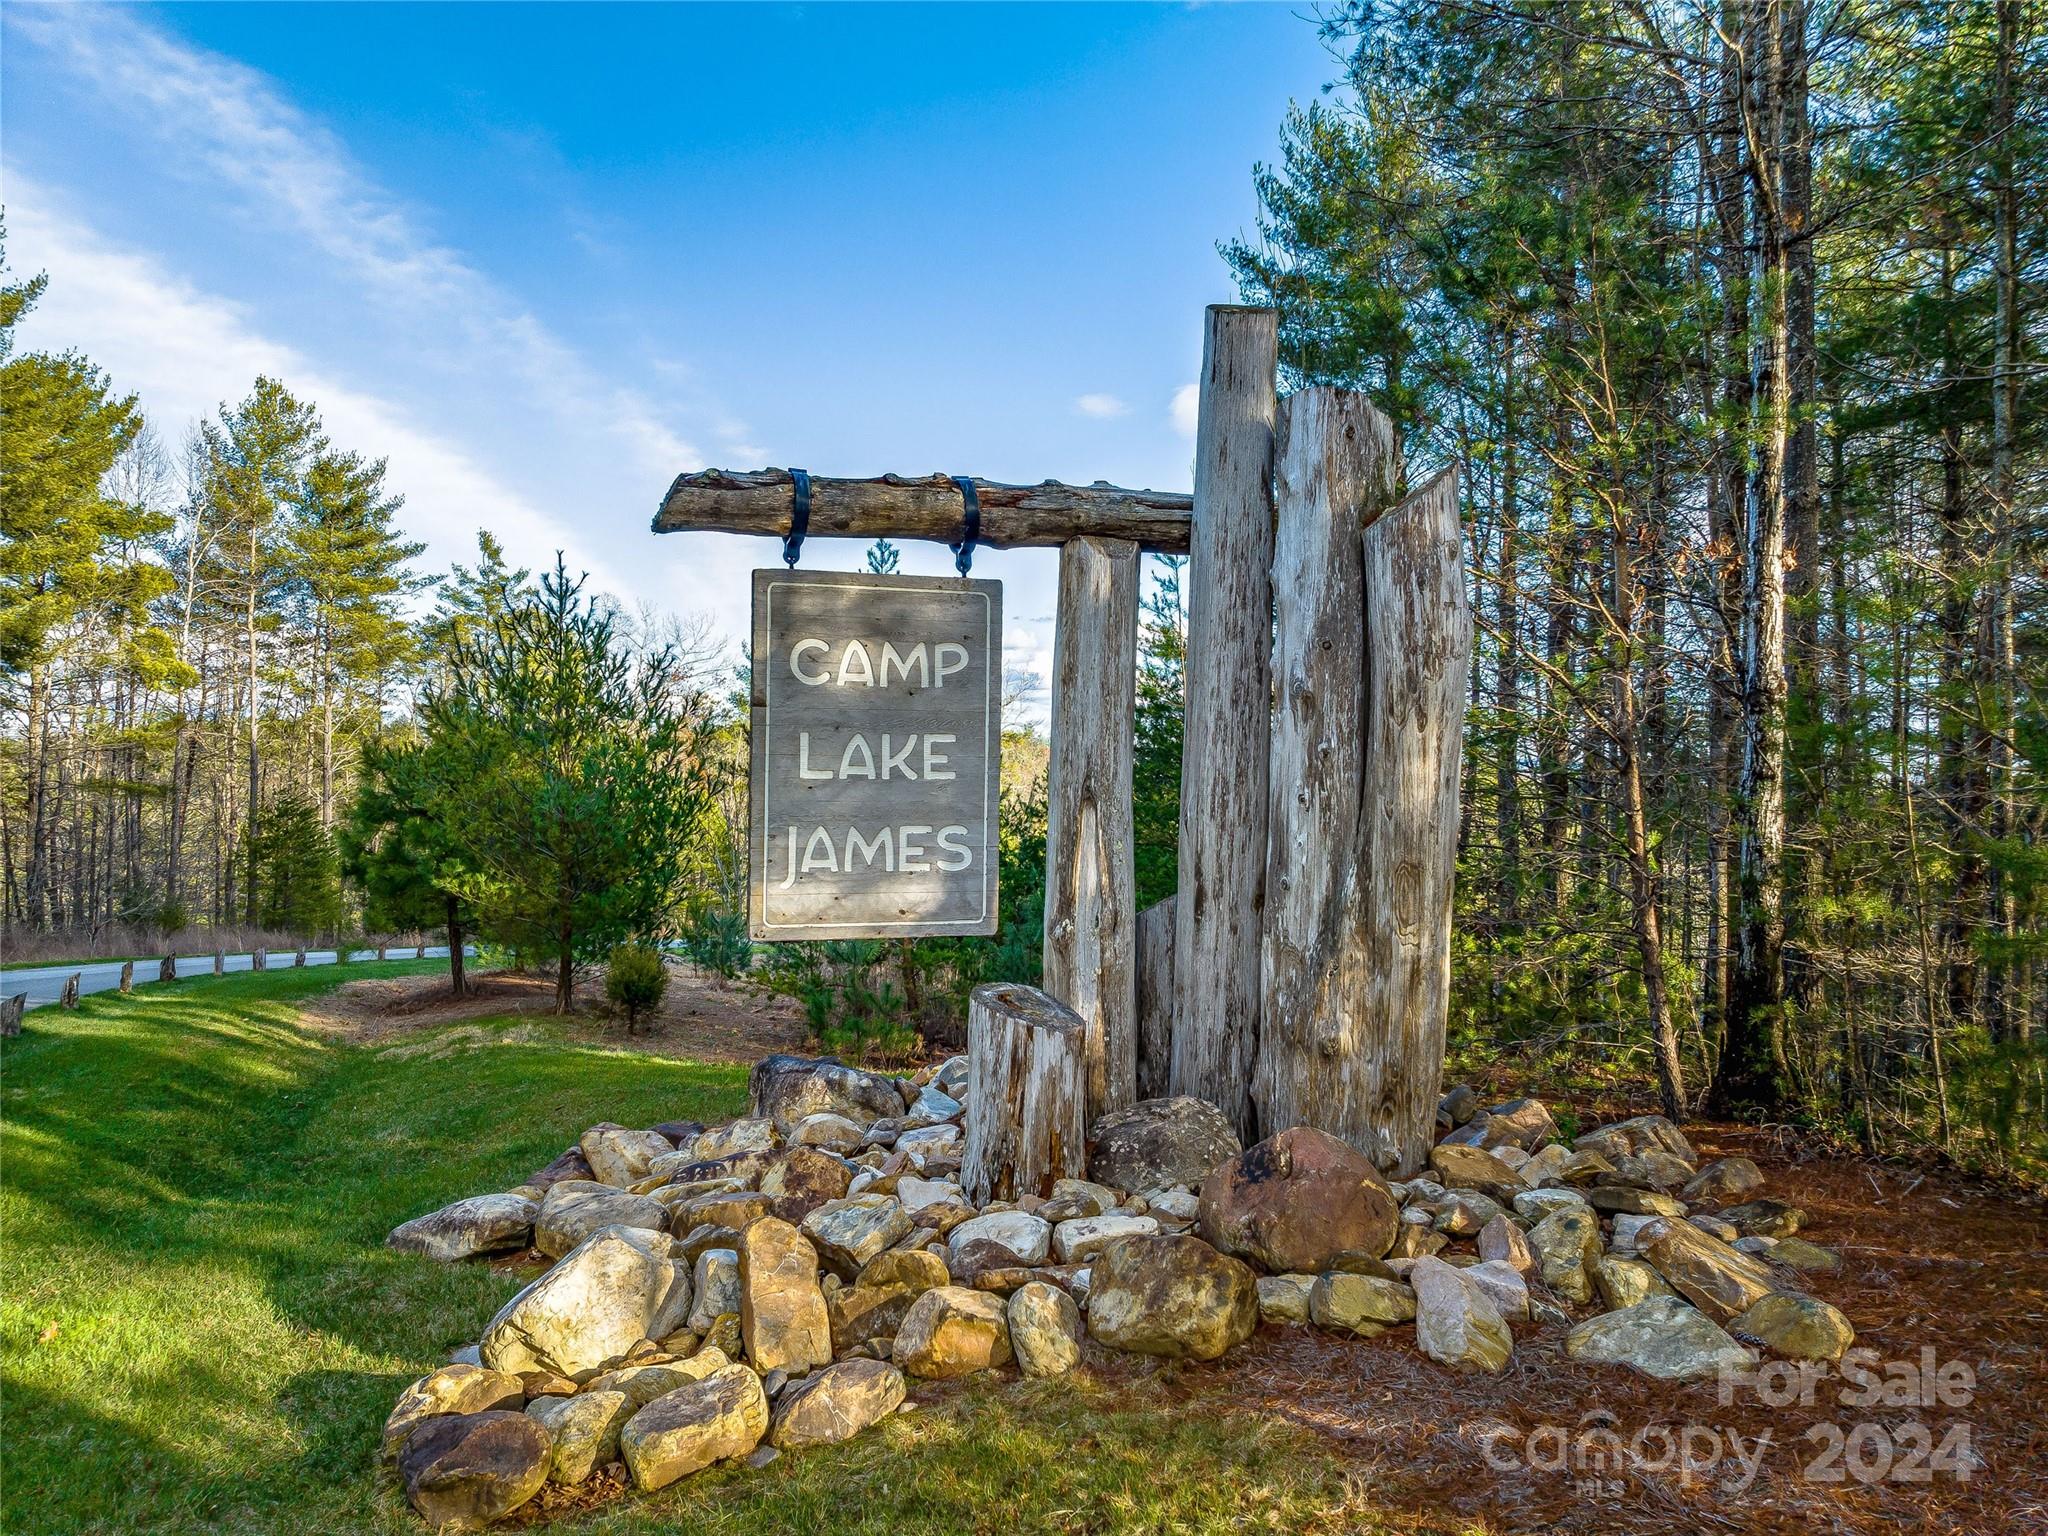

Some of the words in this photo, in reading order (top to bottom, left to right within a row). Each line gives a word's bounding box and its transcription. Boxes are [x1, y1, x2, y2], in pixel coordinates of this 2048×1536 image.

[789, 638, 970, 688] CAMP
[799, 731, 957, 780] LAKE
[780, 824, 973, 890] JAMES
